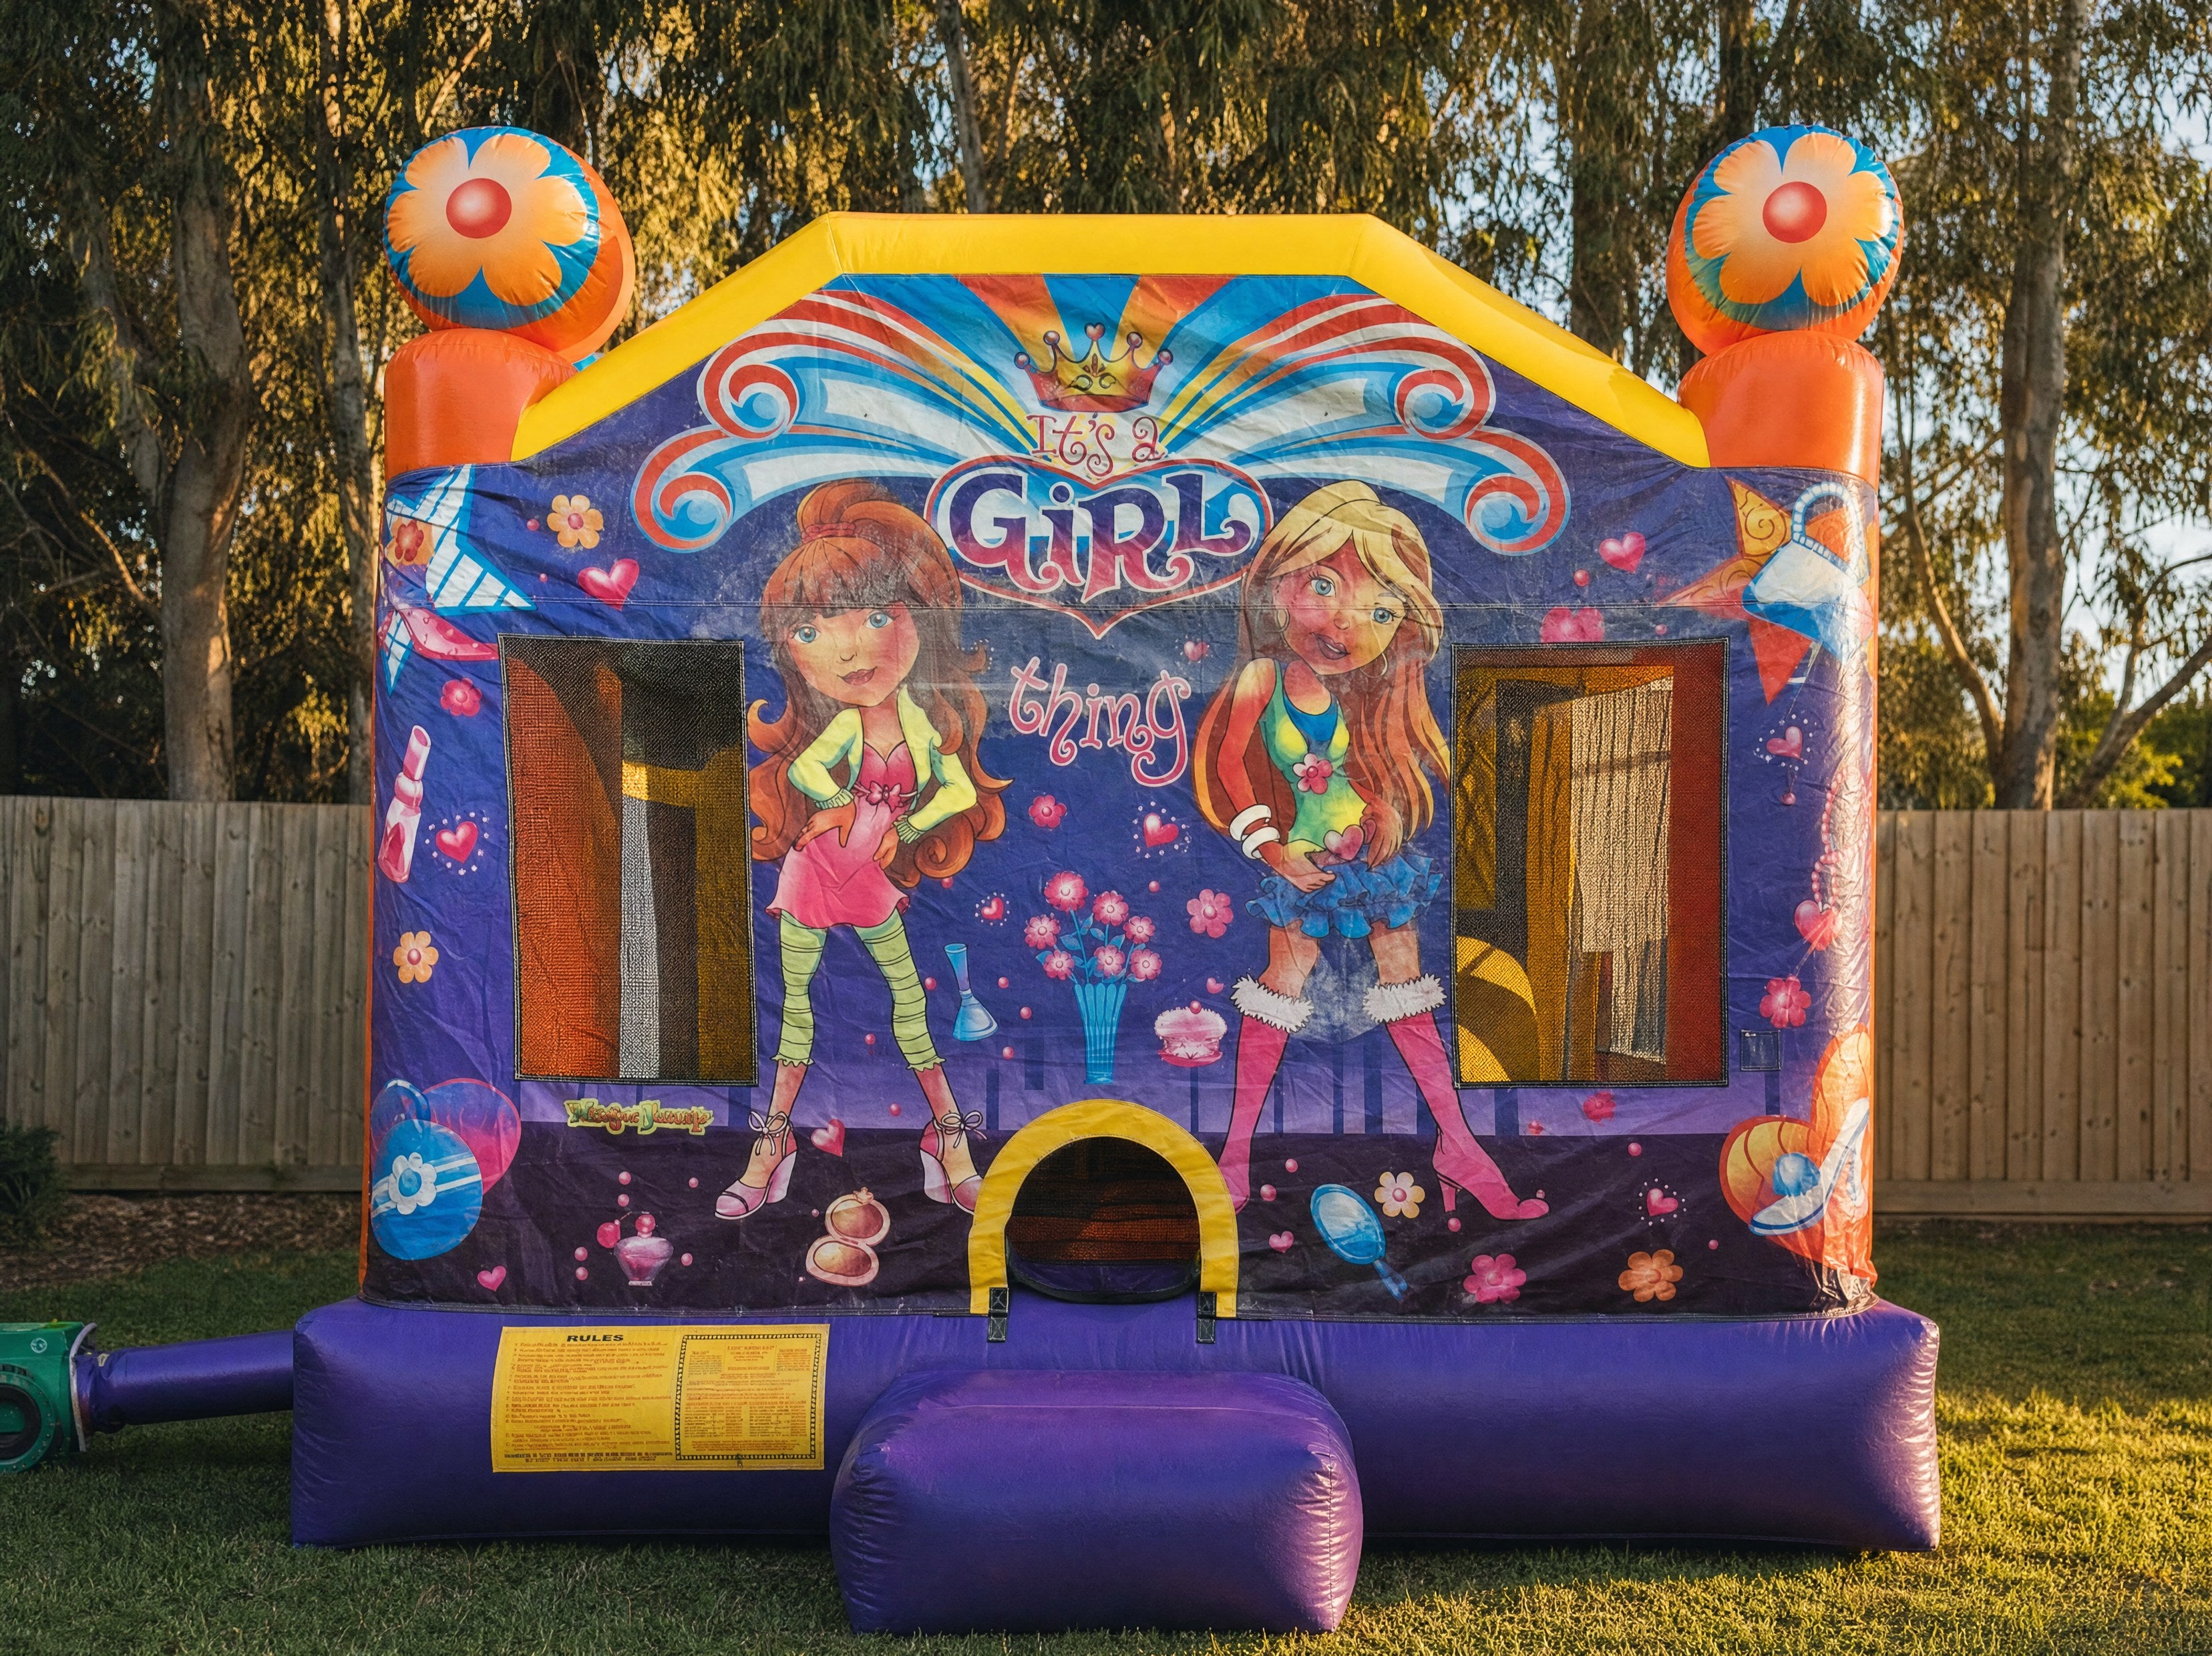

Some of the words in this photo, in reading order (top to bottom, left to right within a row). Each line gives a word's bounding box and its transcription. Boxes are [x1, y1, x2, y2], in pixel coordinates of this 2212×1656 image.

[1026, 415, 1115, 477] It's
[1131, 416, 1166, 463] a
[1008, 656, 1191, 787] thing
